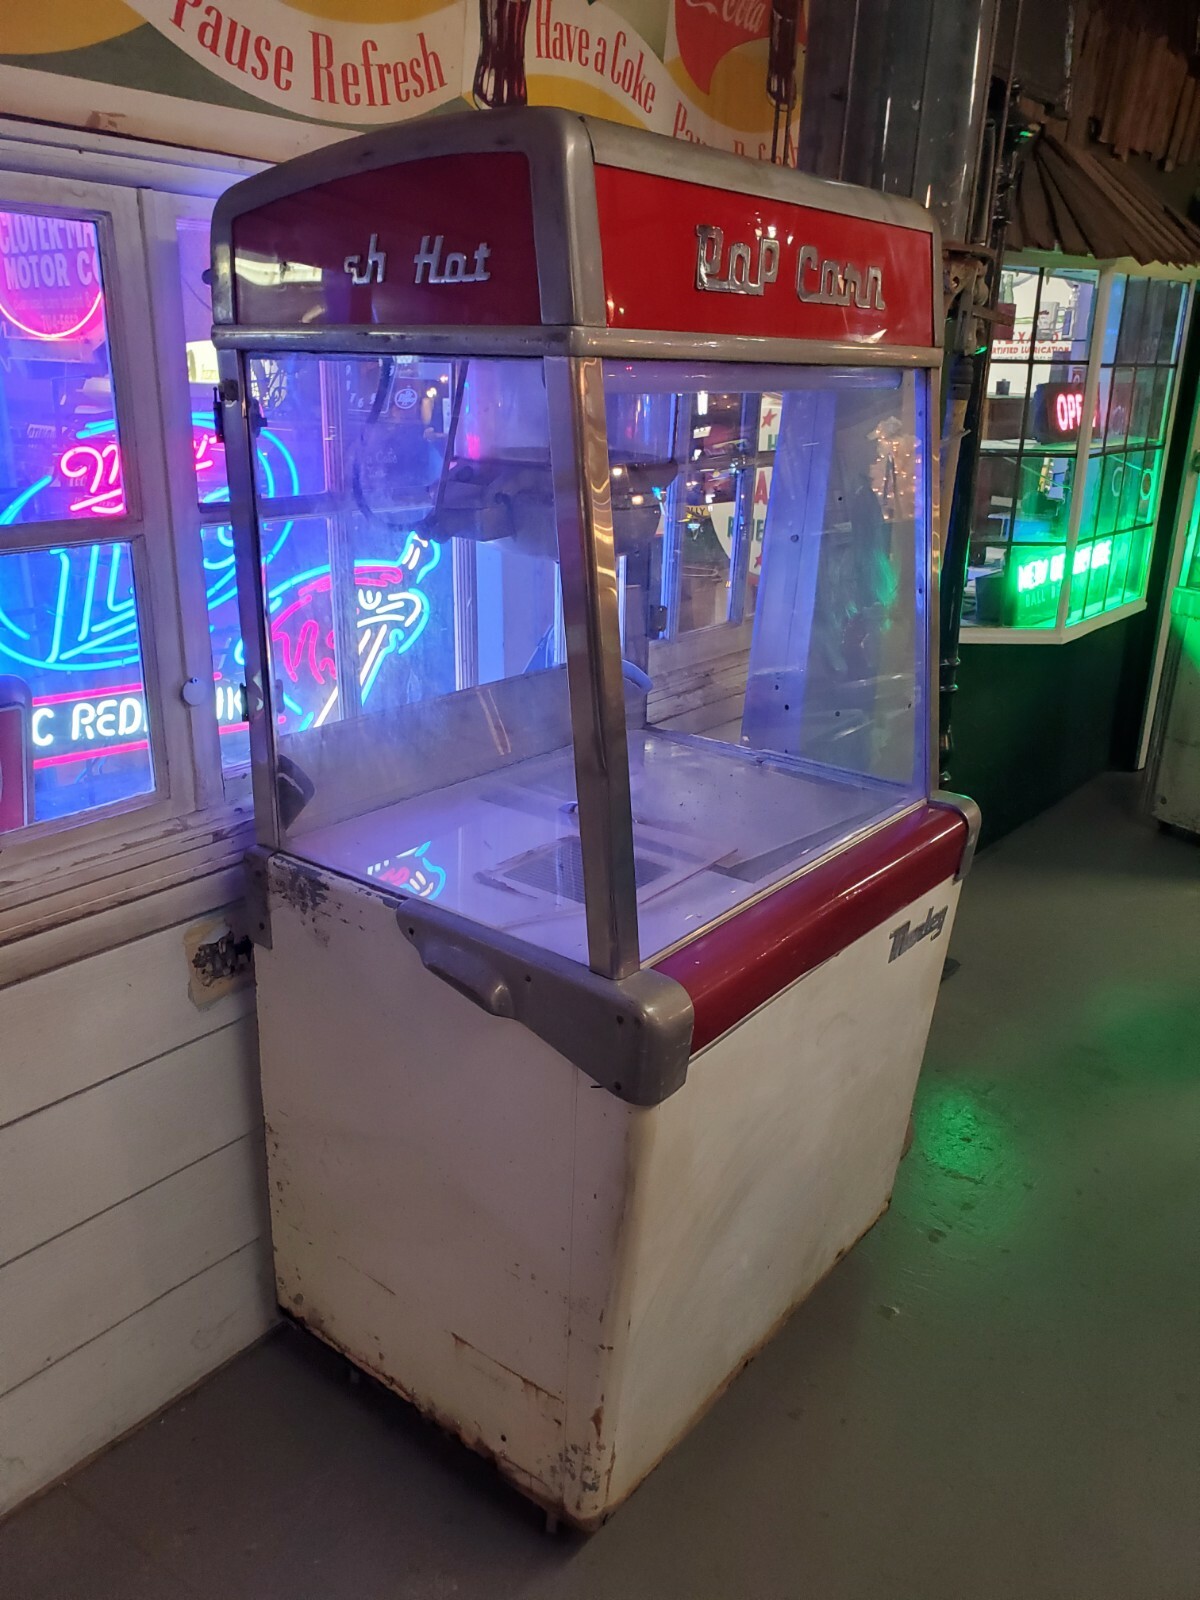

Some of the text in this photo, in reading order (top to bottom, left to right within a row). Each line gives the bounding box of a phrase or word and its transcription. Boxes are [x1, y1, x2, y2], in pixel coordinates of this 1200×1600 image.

[169, 0, 449, 107] Pause Refresh
[536, 0, 590, 67] Have
[610, 30, 656, 114] Coke
[4, 252, 71, 290] MOTOR
[796, 245, 886, 310] Corn
